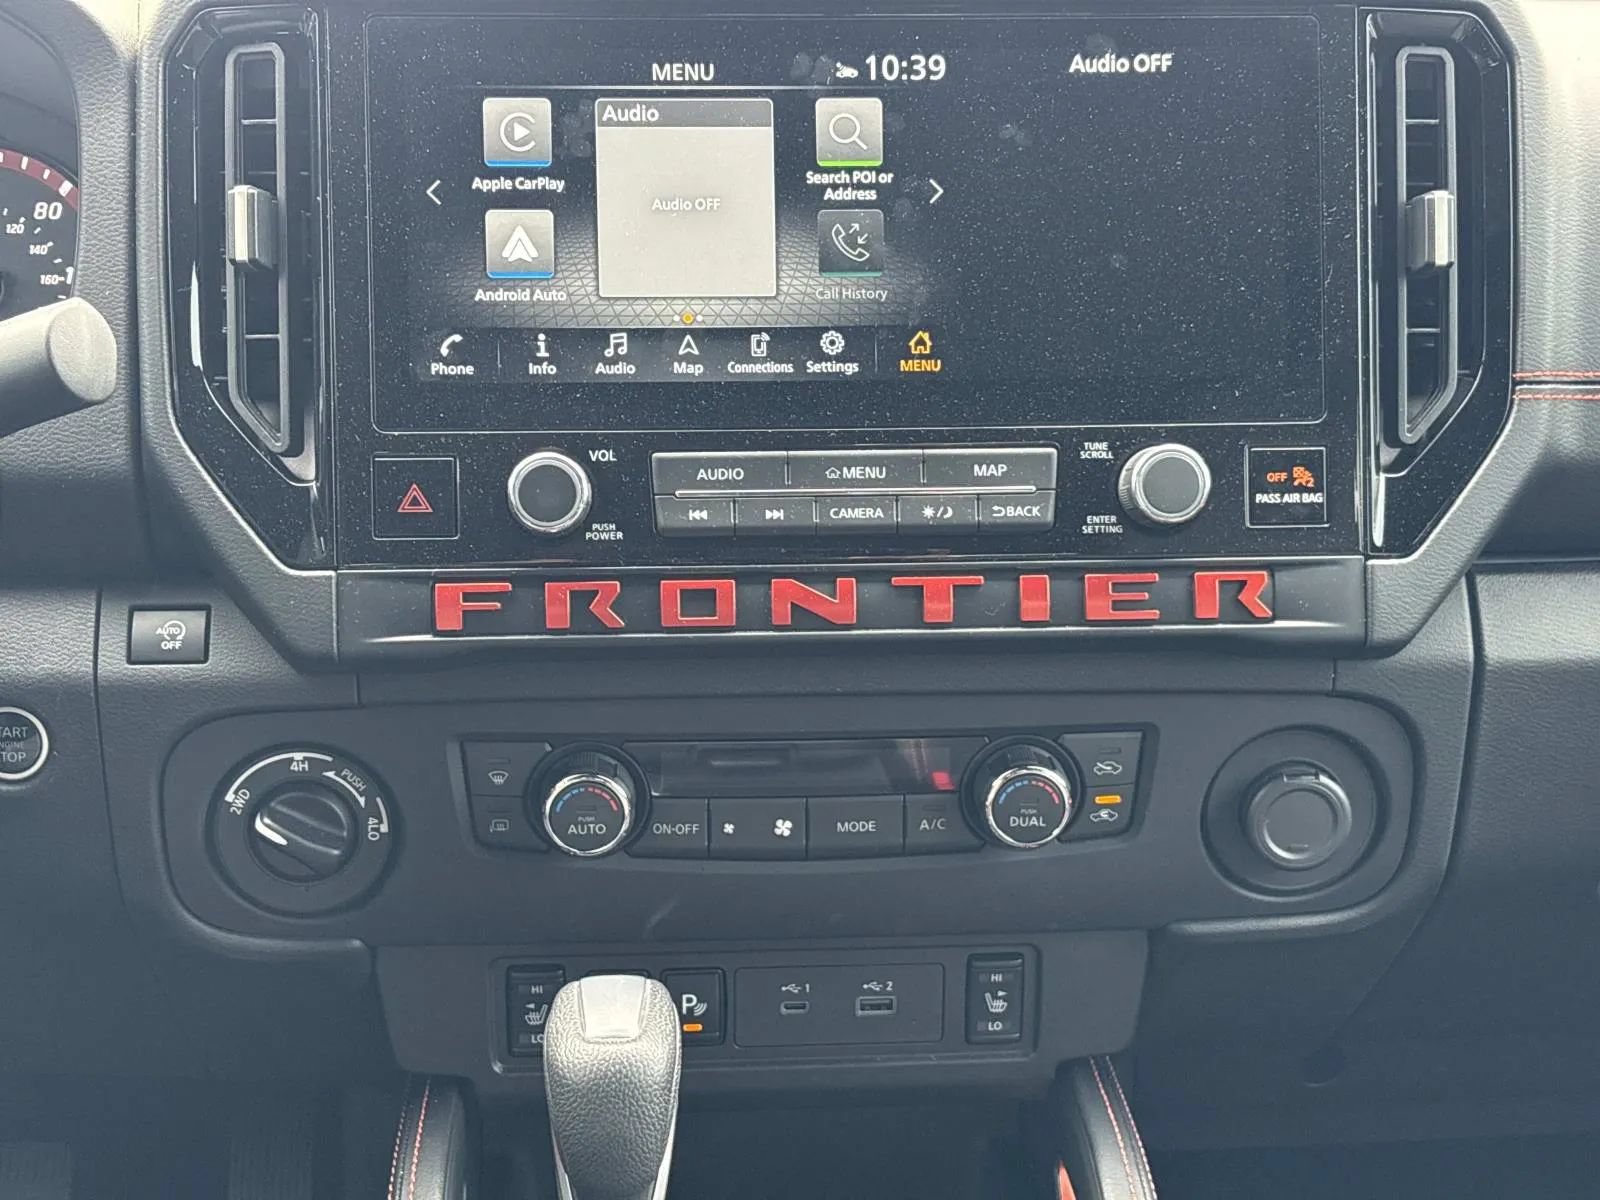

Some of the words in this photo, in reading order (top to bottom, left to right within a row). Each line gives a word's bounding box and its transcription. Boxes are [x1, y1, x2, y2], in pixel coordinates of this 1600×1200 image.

[865, 54, 947, 82] 10:39
[1069, 52, 1130, 73] Audio
[1133, 53, 1173, 73] OFF
[651, 63, 715, 82] MENU
[602, 104, 659, 124] Audio
[806, 170, 850, 184] Search
[853, 170, 876, 184] POI
[878, 173, 894, 184] or
[471, 176, 513, 193] Apple
[514, 177, 565, 193] CarPlay
[823, 187, 877, 201] Address
[33, 201, 63, 220] 80
[651, 197, 692, 212] Audio
[695, 197, 721, 211] OFF
[6, 223, 25, 234] 120
[29, 244, 48, 255] 140
[40, 274, 58, 285] 160
[474, 287, 530, 302] Android
[532, 289, 567, 302] Auto
[815, 287, 839, 300] Call
[842, 288, 888, 302] History
[430, 362, 475, 376] Phone
[528, 361, 557, 375] Info
[595, 361, 637, 375] Audio
[673, 362, 704, 377] Map
[727, 361, 794, 374] Connections
[806, 360, 859, 376] Settings
[899, 359, 942, 373] MENU
[1083, 442, 1109, 451] TUNE
[588, 449, 618, 463] VOL
[1079, 450, 1114, 460] SCROLL
[696, 467, 745, 482] AUDIO
[842, 466, 887, 480] MENU
[973, 463, 1008, 478] MAP
[1266, 472, 1288, 483] OFF
[1255, 493, 1281, 504] PASS
[1282, 493, 1301, 503] AIR
[1302, 492, 1324, 503] BAG
[829, 507, 884, 520] CAMERA
[1006, 505, 1041, 518] BACK
[1086, 515, 1117, 525] ENTER
[591, 523, 617, 533] PUSH
[1082, 525, 1124, 535] SETTING
[585, 532, 624, 541] POWER
[434, 571, 1273, 631] FRONTIER
[156, 626, 181, 637] AUTO
[161, 640, 183, 651] OFF
[0, 726, 29, 738] TART
[0, 751, 27, 763] TOP
[290, 760, 309, 772] 4H
[340, 768, 367, 793] PUSH
[229, 788, 251, 816] 2WD
[367, 816, 381, 842] 4LO
[836, 820, 877, 834] MODE
[919, 818, 947, 831] A/C
[1009, 816, 1047, 829] DUAL
[567, 823, 607, 836] AUTO
[652, 823, 700, 836] ON-OFF
[990, 973, 1003, 983] HI
[530, 984, 544, 994] HI
[805, 983, 810, 993] 1
[885, 981, 893, 991] 2
[682, 994, 698, 1015] P
[988, 1020, 1003, 1031] LO
